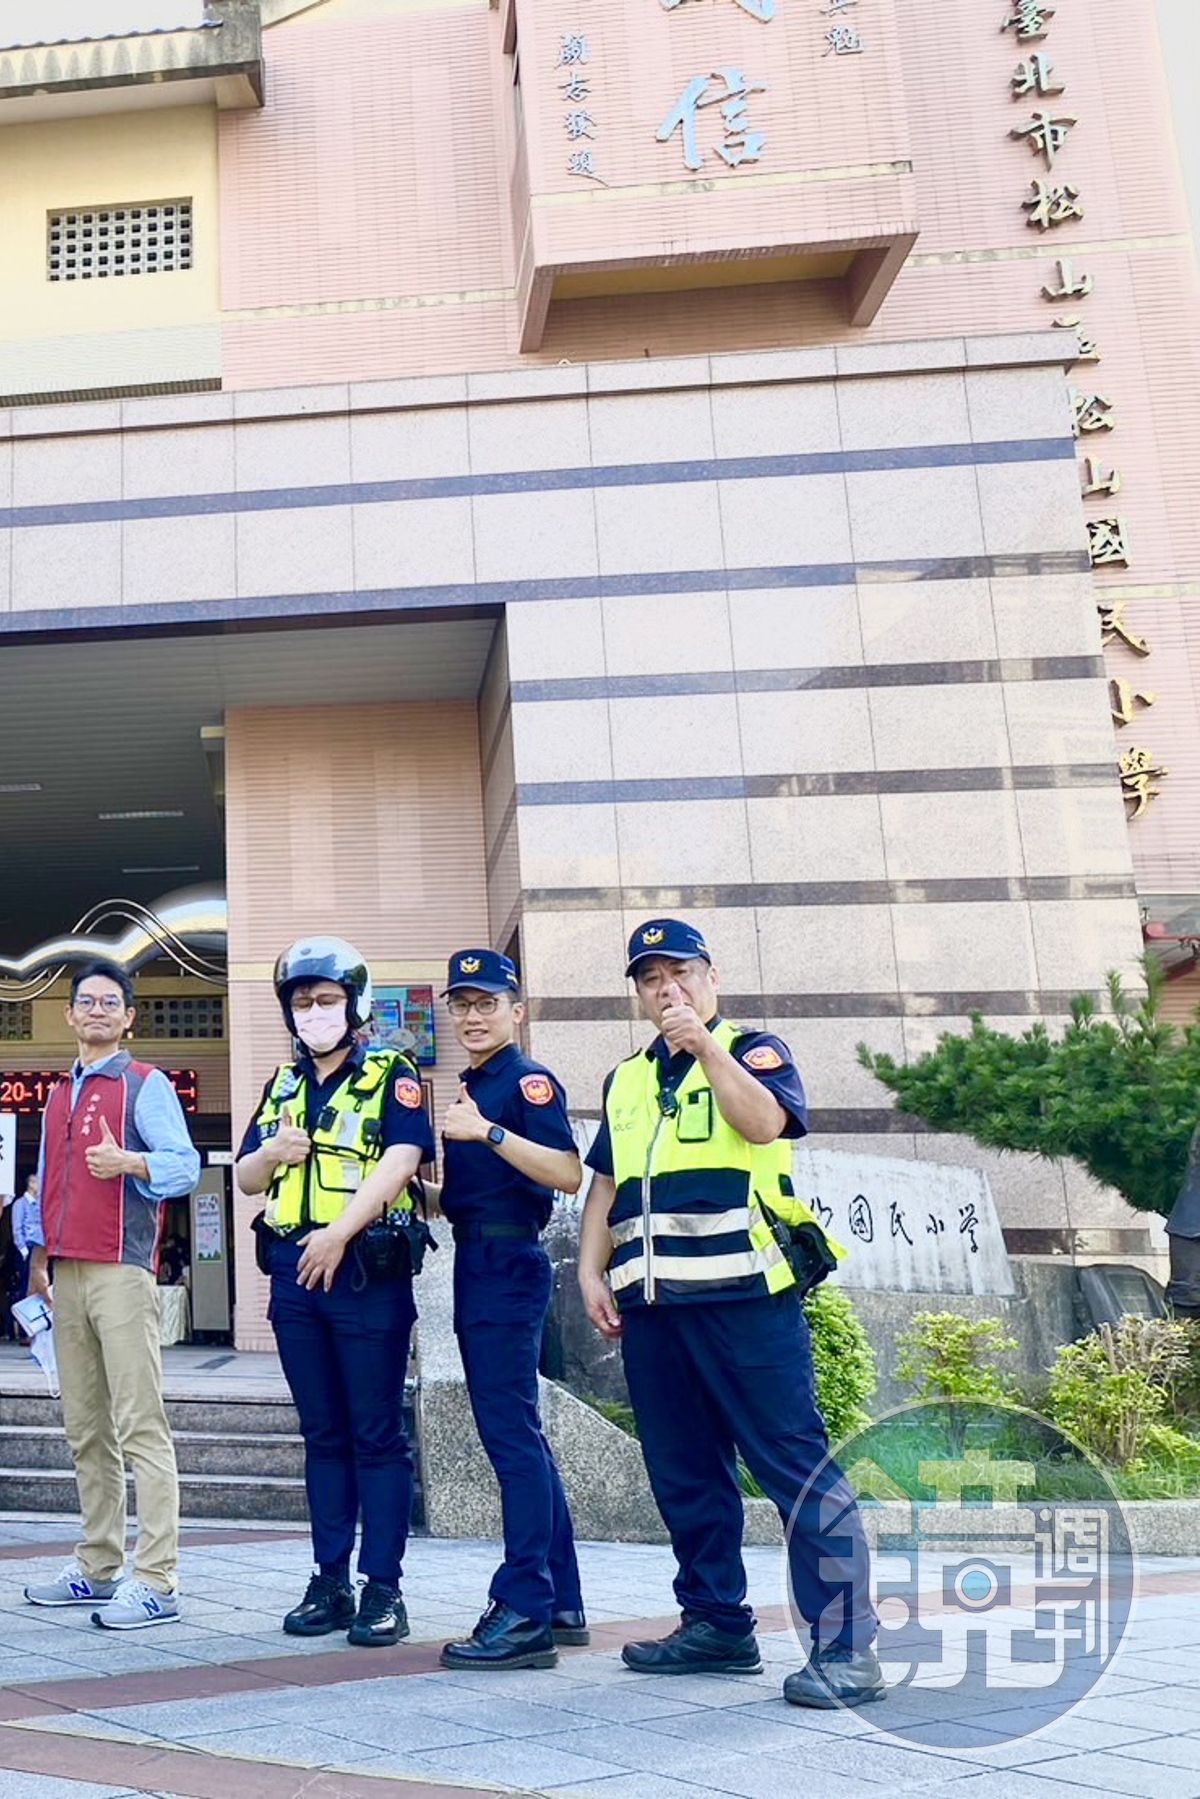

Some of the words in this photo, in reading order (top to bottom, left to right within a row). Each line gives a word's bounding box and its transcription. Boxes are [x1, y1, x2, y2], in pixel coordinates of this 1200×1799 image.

[656, 0, 777, 170] 信
[69, 1579, 91, 1598] N
[142, 1597, 161, 1616] N
